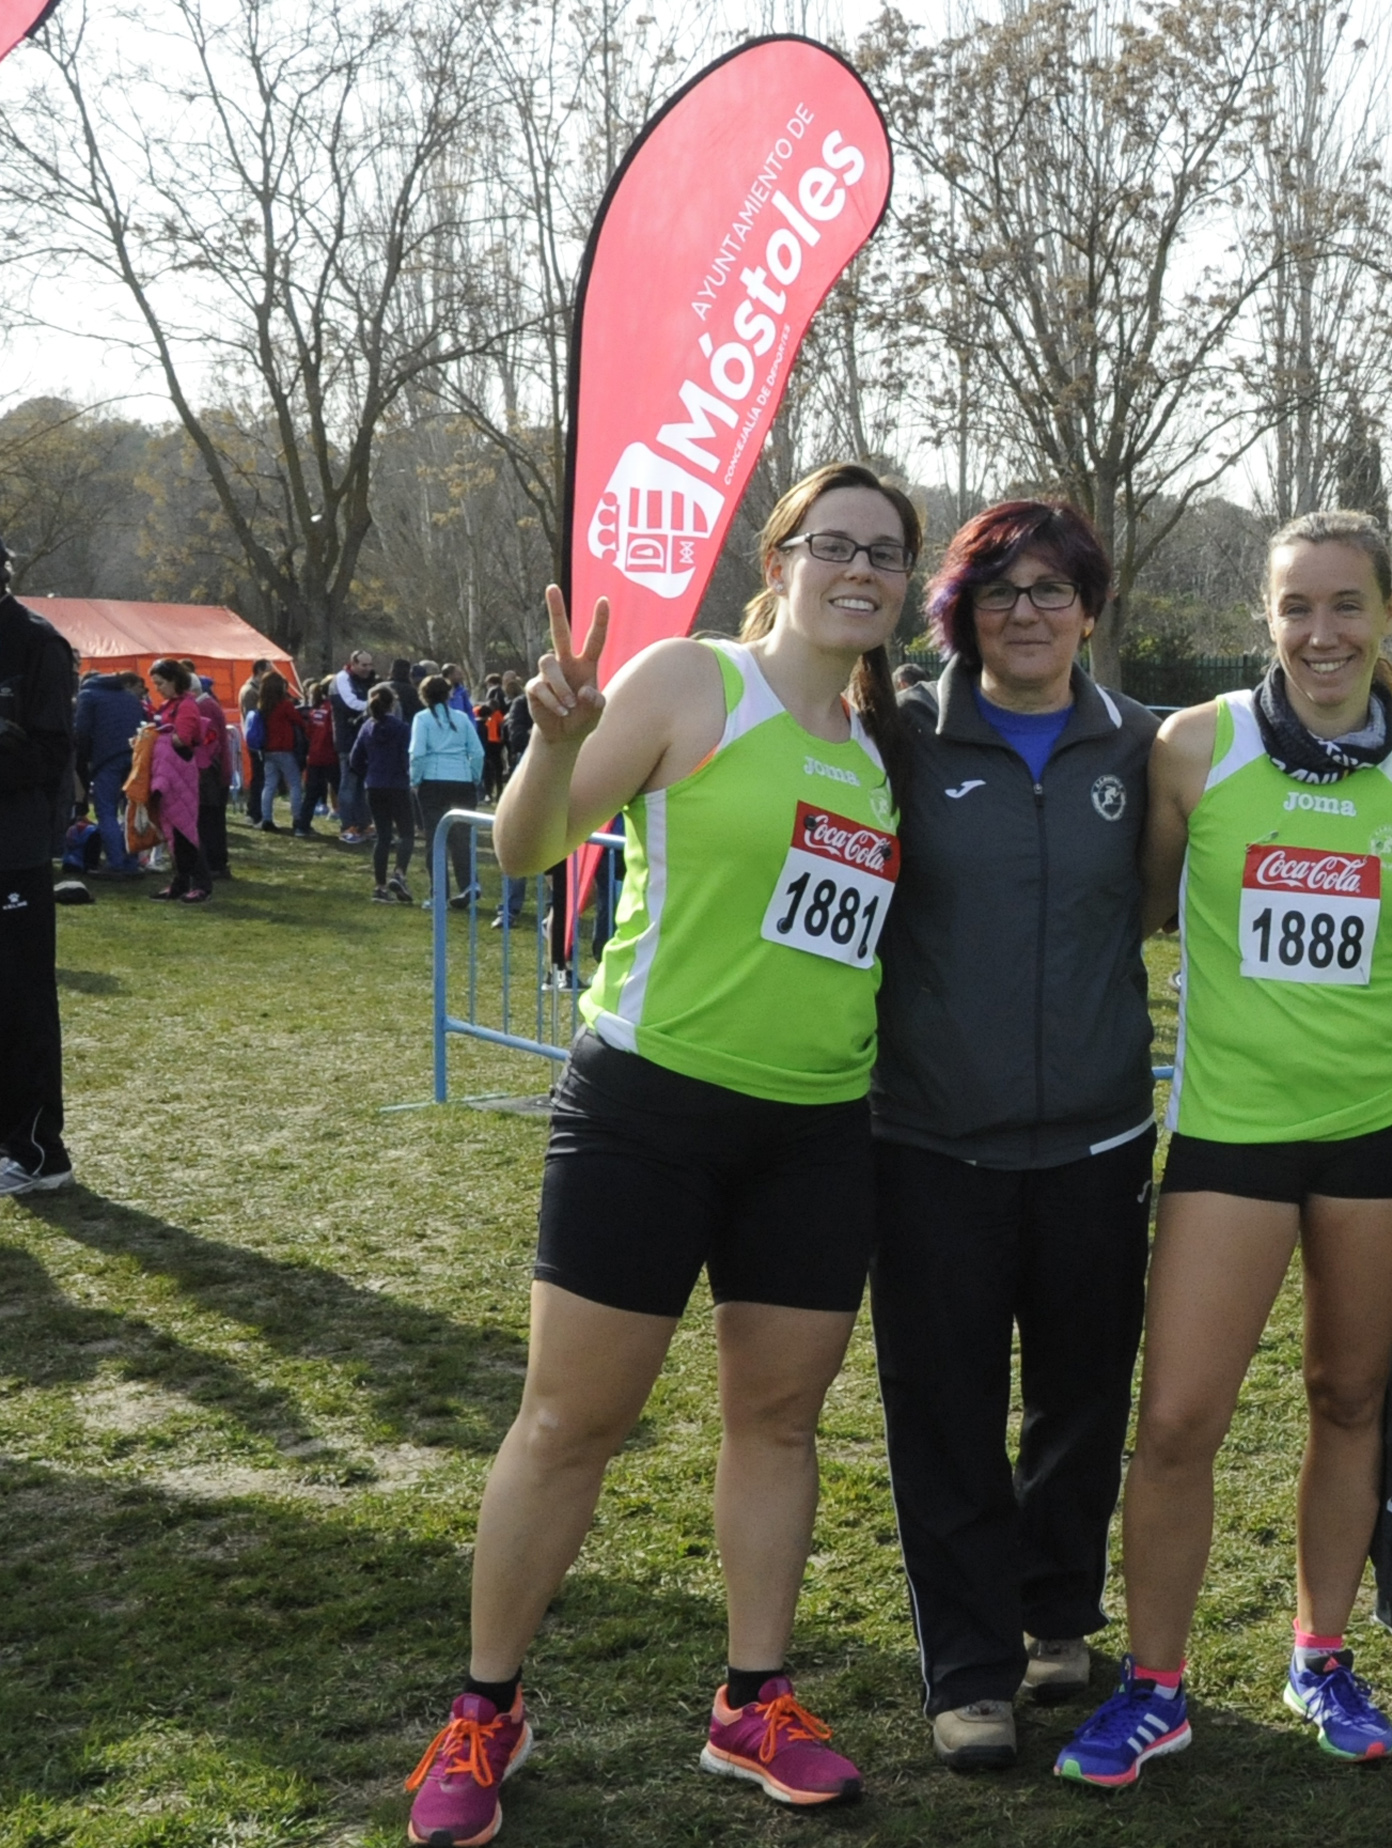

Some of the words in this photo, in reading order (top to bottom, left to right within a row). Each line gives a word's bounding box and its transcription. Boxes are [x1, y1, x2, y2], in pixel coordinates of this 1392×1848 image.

[691, 138, 793, 321] AYUNTAMIENTO
[786, 101, 815, 139] DE
[656, 129, 866, 474] Móstoles
[756, 385, 772, 407] DE
[803, 756, 861, 787] Joma
[1283, 791, 1357, 817] Joma
[803, 814, 889, 873] Coca-Cola
[1256, 850, 1367, 893] Coca-Cola
[785, 871, 880, 955] 1881
[1251, 907, 1365, 970] 1888
